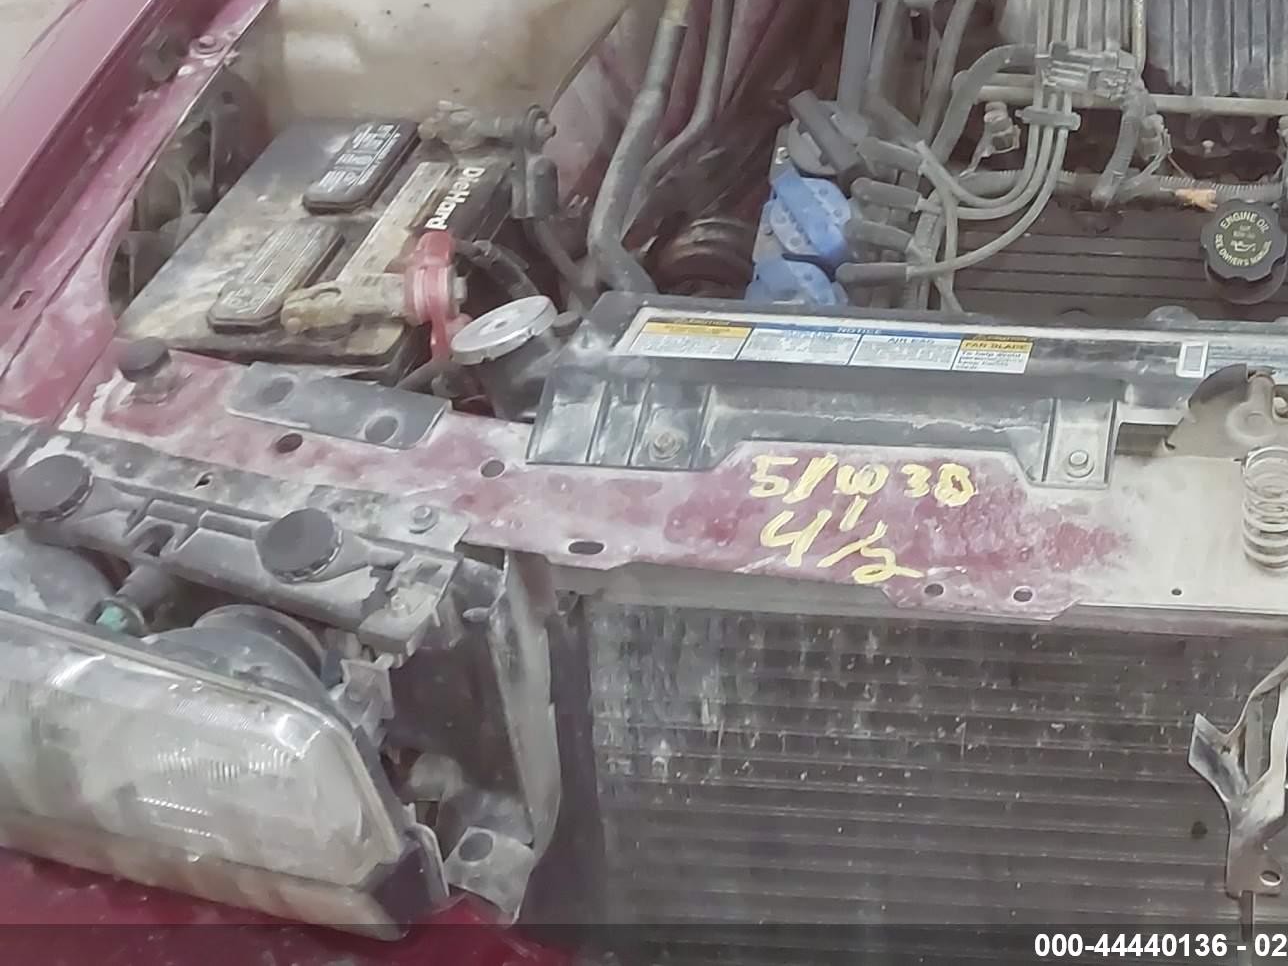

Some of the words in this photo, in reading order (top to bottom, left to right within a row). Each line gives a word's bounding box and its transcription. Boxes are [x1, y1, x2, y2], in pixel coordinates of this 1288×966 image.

[424, 166, 486, 230] DieHard
[1220, 211, 1257, 230] ENGINE
[1256, 218, 1271, 233] OIL
